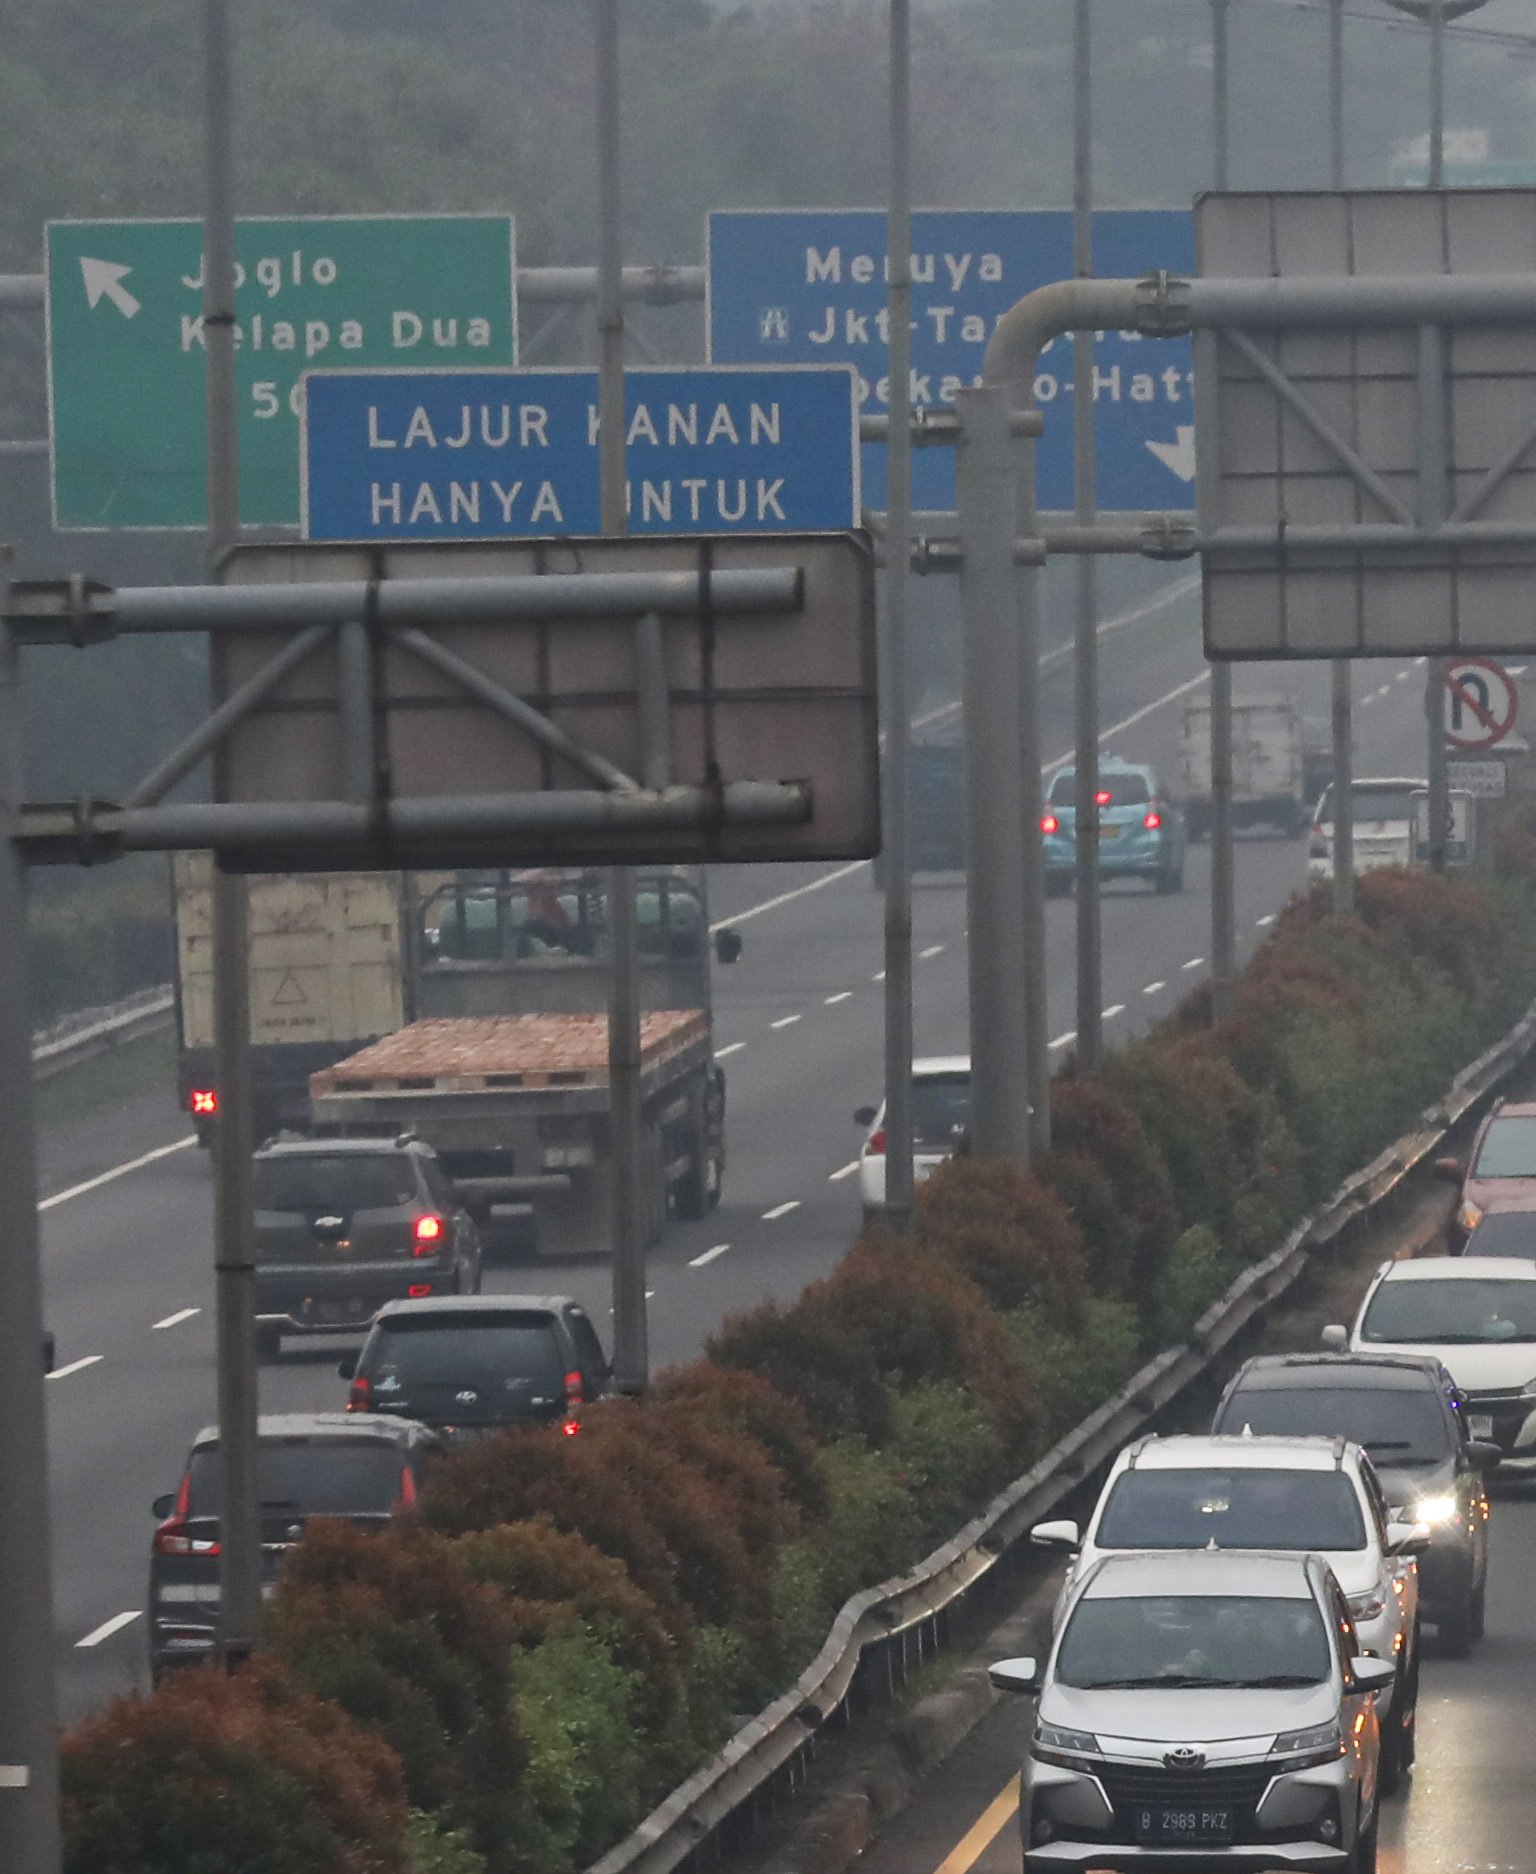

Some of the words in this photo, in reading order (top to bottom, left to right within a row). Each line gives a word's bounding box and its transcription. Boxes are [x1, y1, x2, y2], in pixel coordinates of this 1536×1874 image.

[806, 246, 1003, 291] Meuya
[393, 311, 490, 348] Dua
[368, 405, 549, 448] LAJUR
[371, 481, 563, 524] HANYA
[625, 479, 786, 522] NTUK
[1142, 1812, 1151, 1829] B
